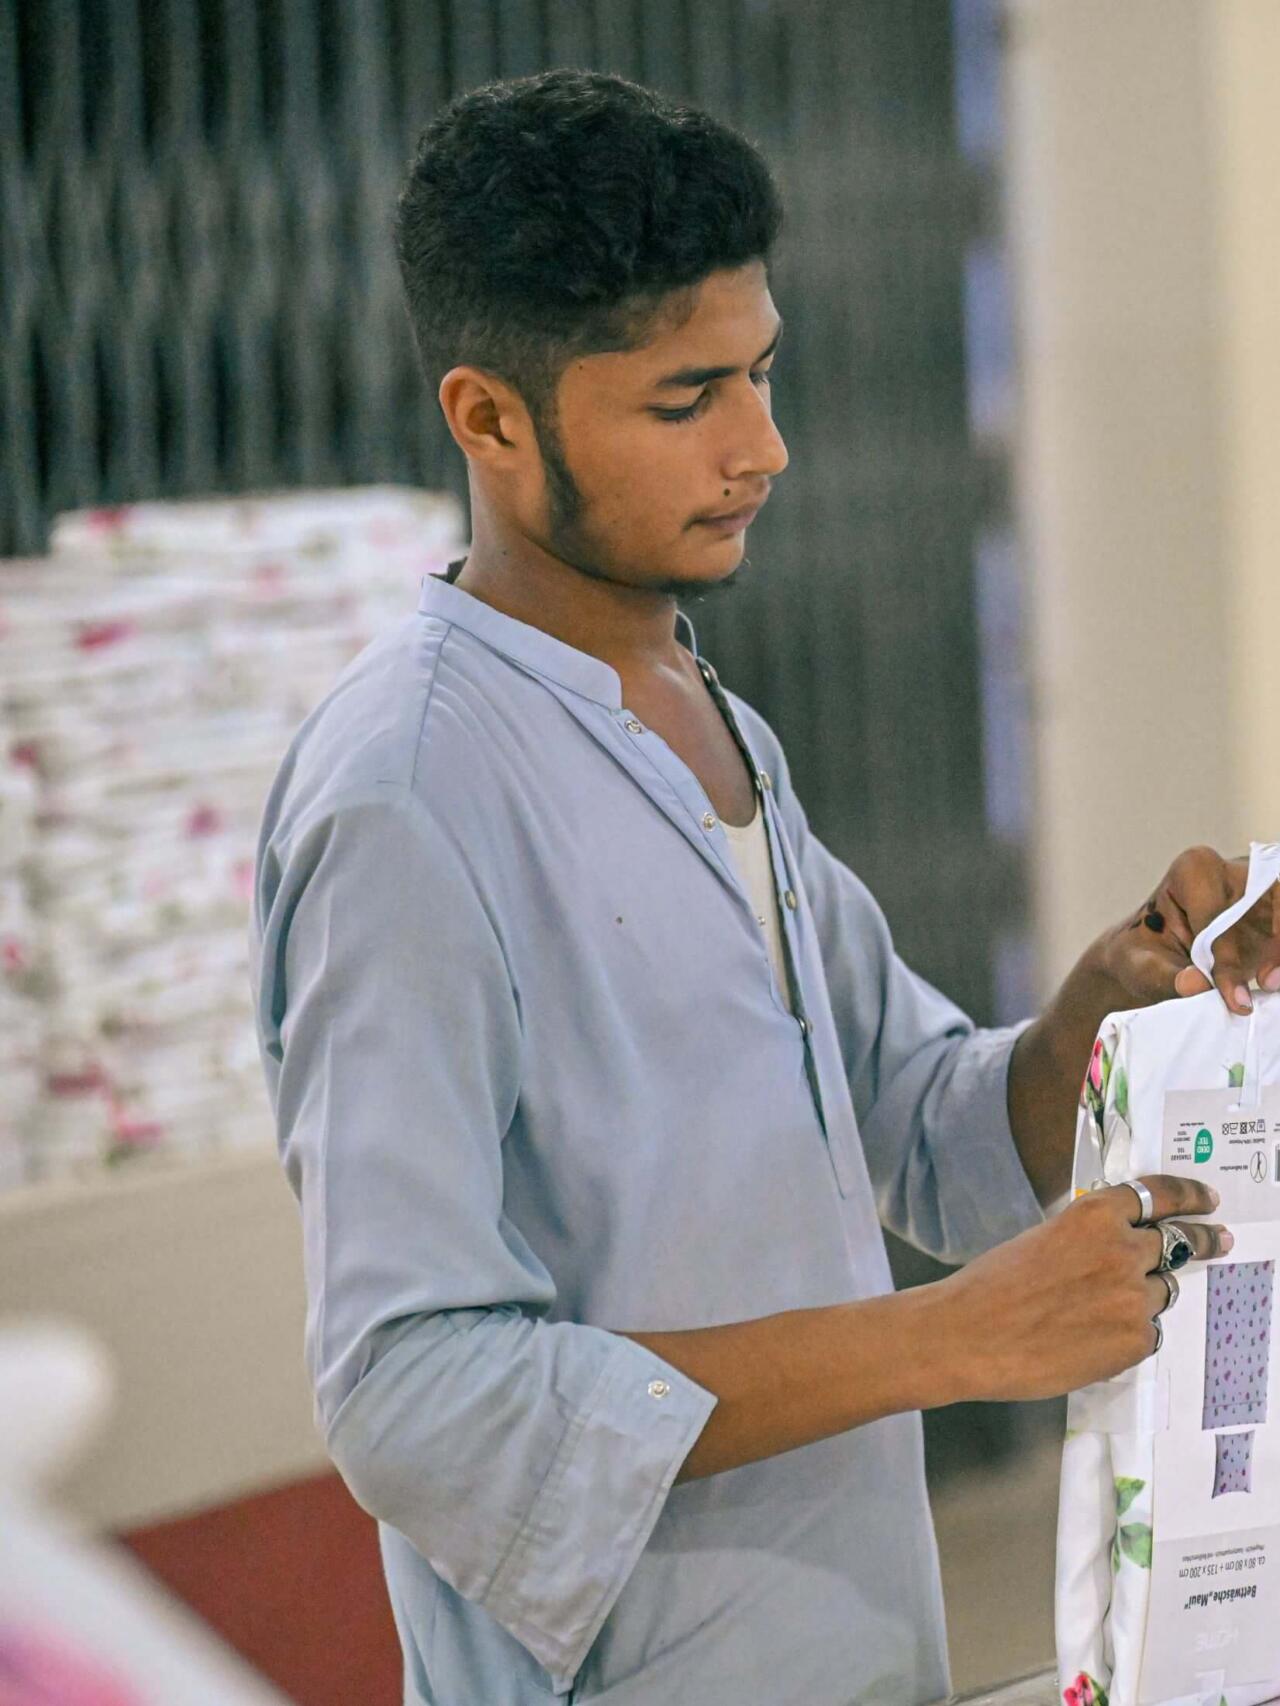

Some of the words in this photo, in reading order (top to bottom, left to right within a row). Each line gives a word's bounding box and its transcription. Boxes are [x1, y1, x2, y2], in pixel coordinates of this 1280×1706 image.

[1225, 1561, 1234, 1571] cm
[1235, 1560, 1244, 1571] 80
[1248, 1558, 1256, 1569] 80
[1179, 1568, 1189, 1578] cm
[1189, 1566, 1201, 1579] 200
[1207, 1564, 1218, 1576] 135
